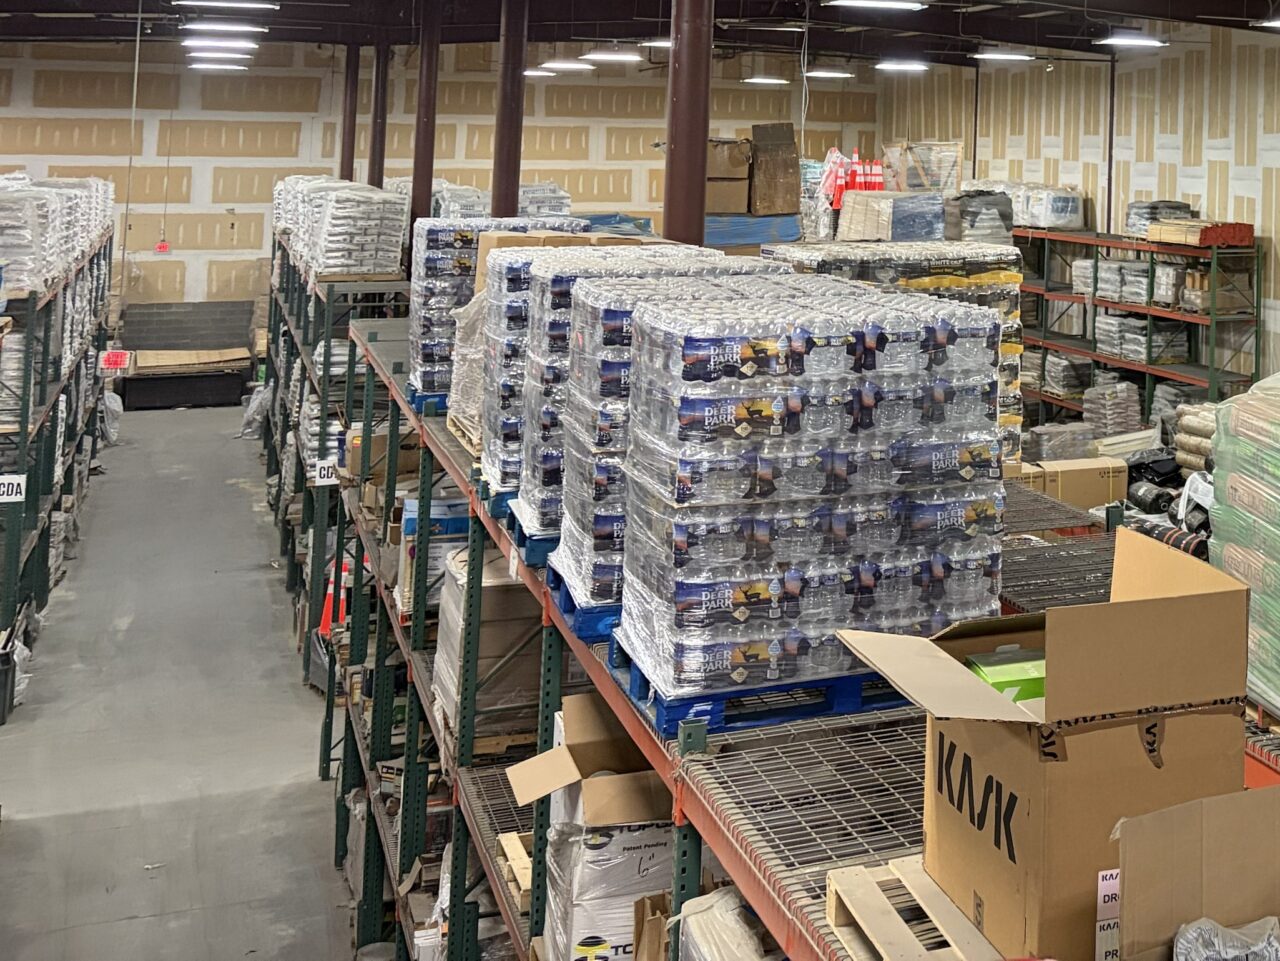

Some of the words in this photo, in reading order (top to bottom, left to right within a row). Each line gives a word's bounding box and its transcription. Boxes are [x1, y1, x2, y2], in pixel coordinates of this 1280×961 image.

[710, 344, 742, 355] DEER
[710, 353, 742, 366] PARK
[704, 405, 736, 416] DEER
[704, 414, 736, 426] PARK
[932, 449, 960, 460] DEER
[932, 458, 960, 470] PARK
[319, 465, 337, 479] CD
[936, 508, 966, 520] DEER
[936, 518, 966, 531] PARK
[701, 589, 733, 601] DEER
[701, 599, 733, 611] PARK
[700, 649, 732, 663] DEER
[700, 659, 732, 672] PARK
[937, 730, 1018, 865] KASK
[622, 844, 642, 852] Patent
[643, 841, 668, 850] Pending
[1103, 892, 1120, 904] DR
